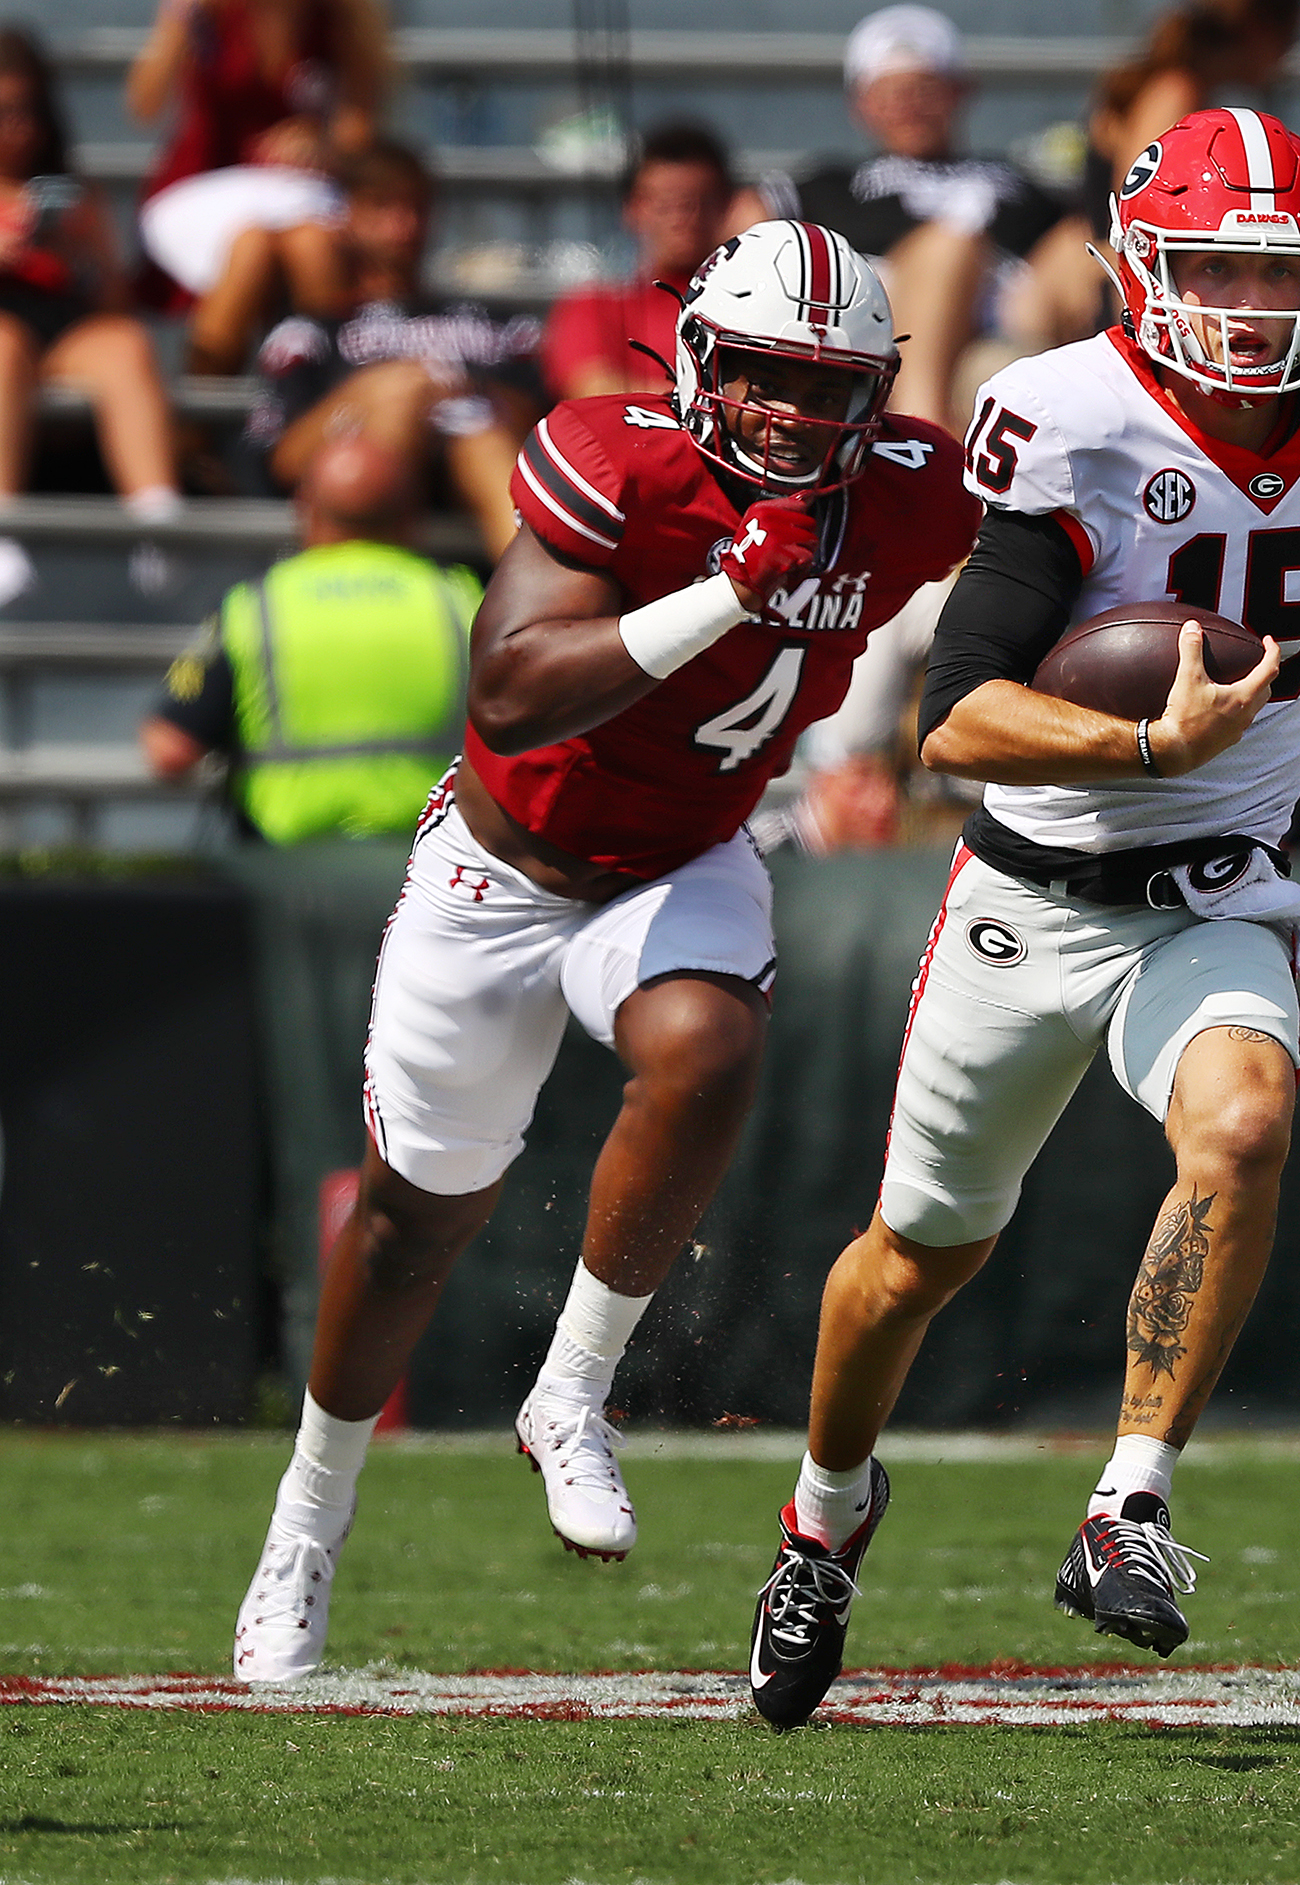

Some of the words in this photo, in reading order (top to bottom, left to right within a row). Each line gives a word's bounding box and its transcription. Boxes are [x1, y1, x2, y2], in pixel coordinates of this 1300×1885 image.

[1122, 144, 1160, 197] G
[1236, 213, 1290, 225] DAWGS
[622, 404, 682, 430] 4
[871, 439, 935, 470] 4
[962, 396, 1039, 494] 15
[1147, 471, 1192, 520] SEC
[1249, 472, 1285, 499] G
[694, 648, 806, 771] 4
[1187, 851, 1251, 892] G
[967, 921, 1025, 966] G
